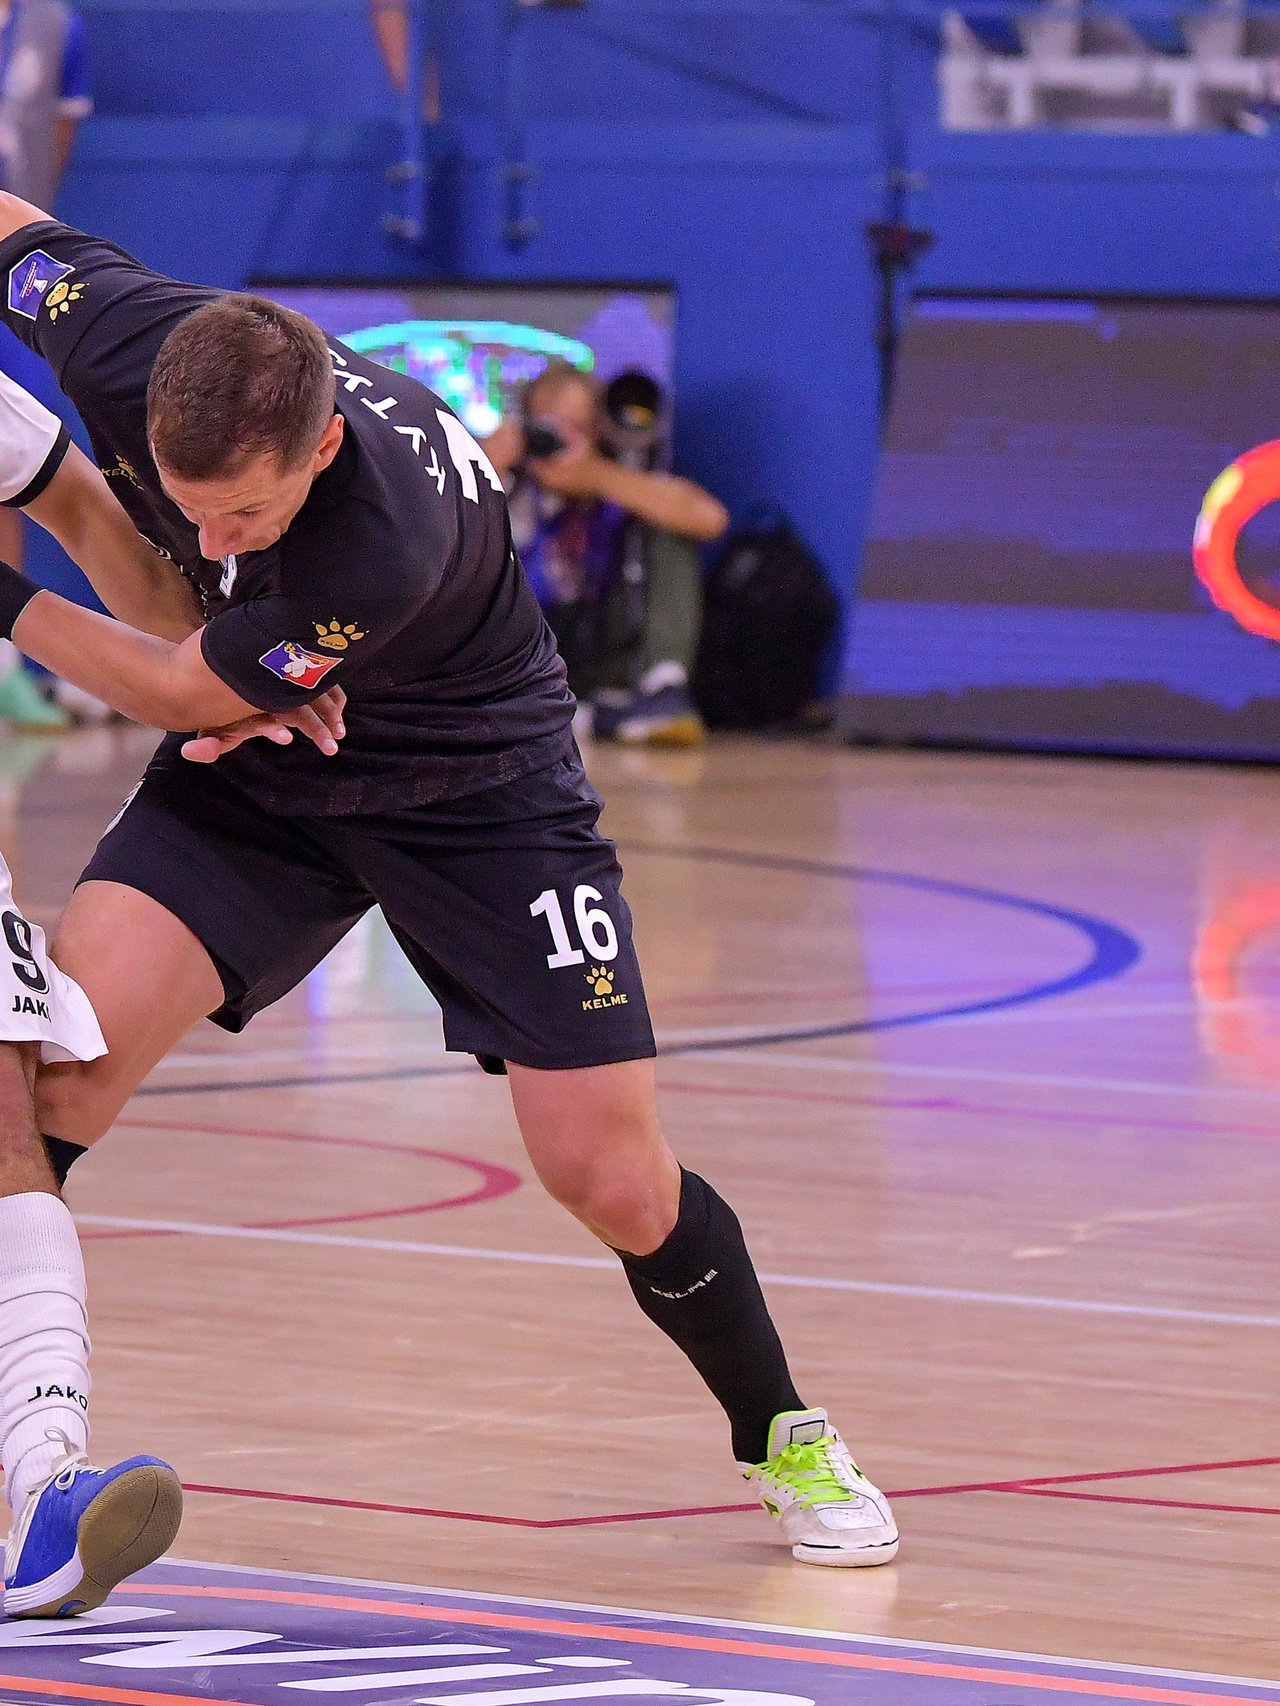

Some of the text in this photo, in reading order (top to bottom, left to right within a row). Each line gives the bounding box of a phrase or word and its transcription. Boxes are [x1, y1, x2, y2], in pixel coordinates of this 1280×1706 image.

[101, 468, 145, 491] KEL
[529, 884, 618, 969] 16
[1, 910, 49, 994] 9
[12, 995, 51, 1023] JAK
[582, 994, 628, 1011] KELME
[28, 1385, 88, 1411] JAKO
